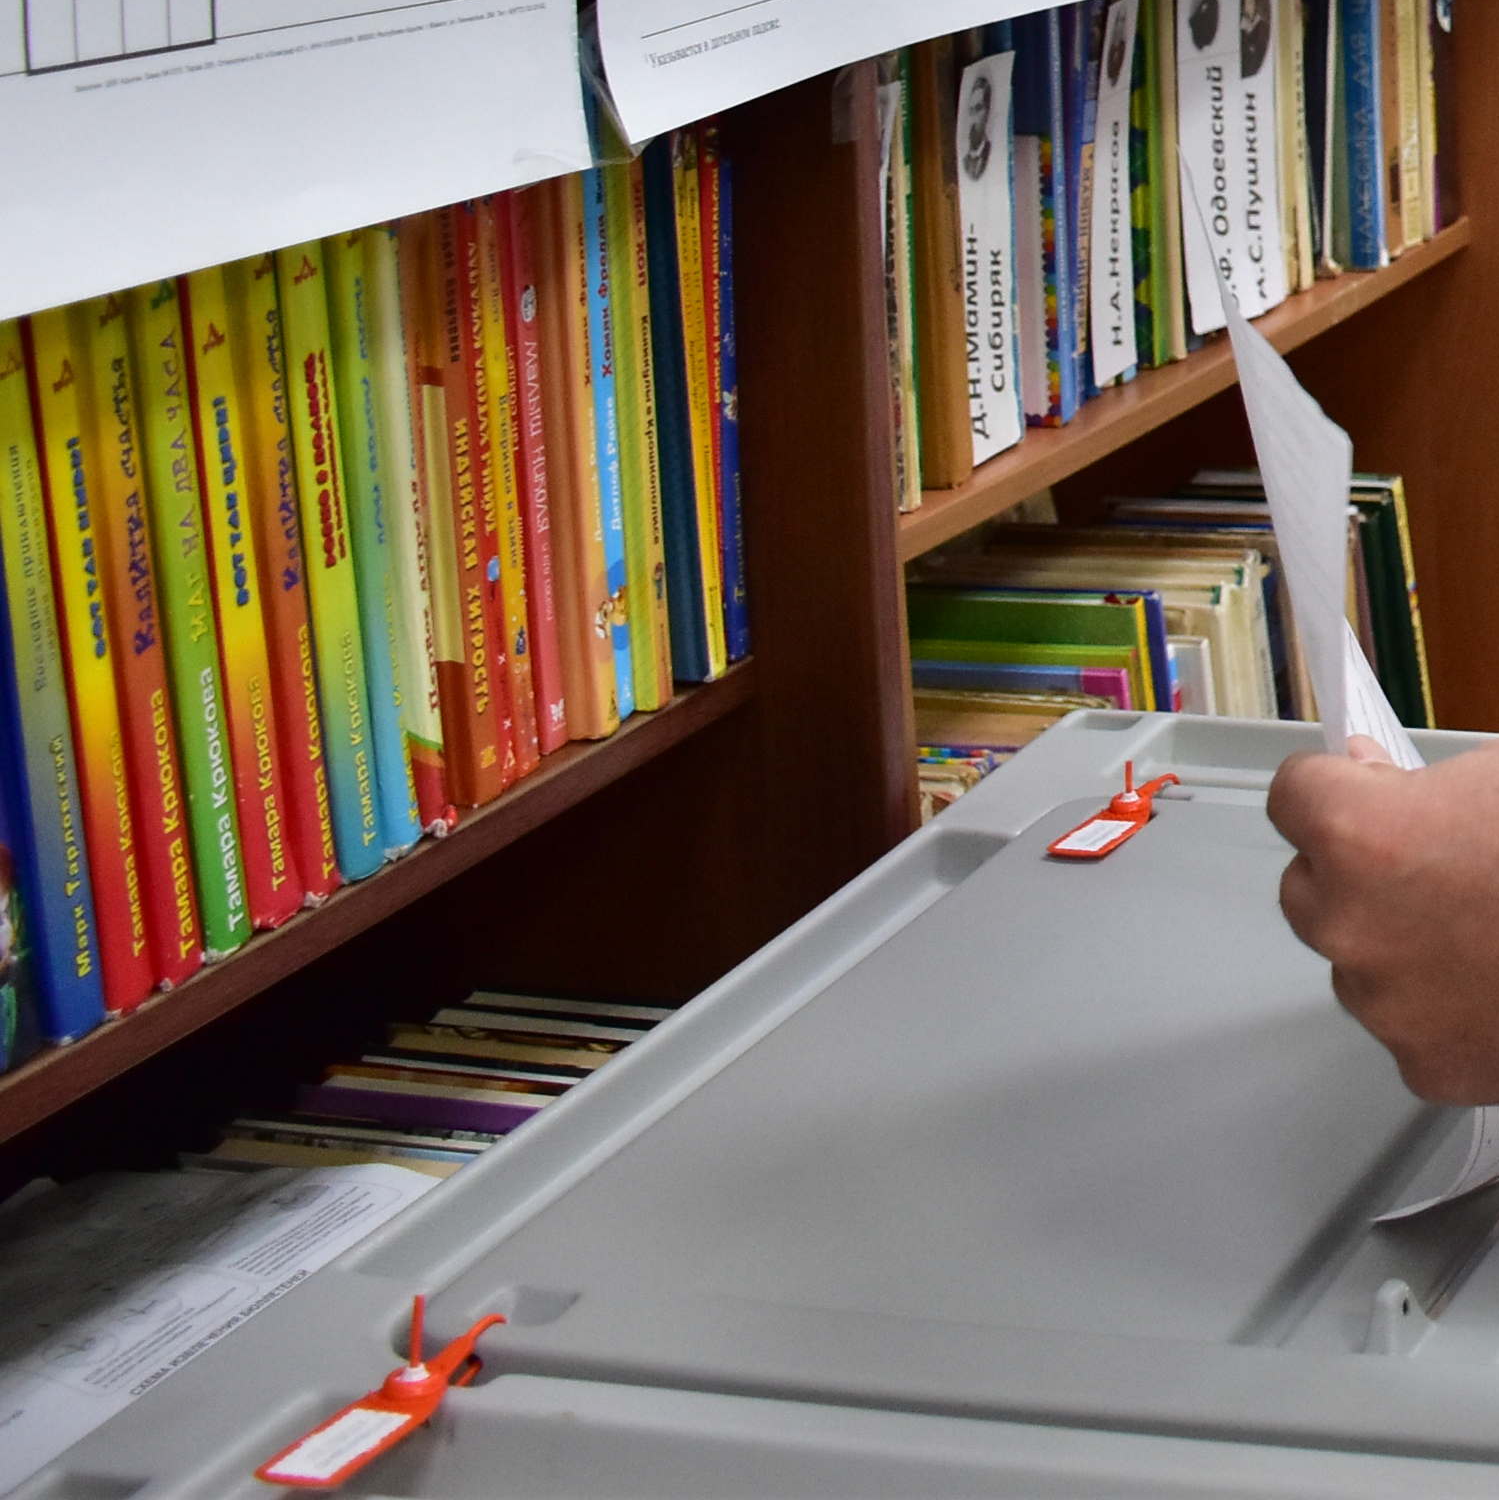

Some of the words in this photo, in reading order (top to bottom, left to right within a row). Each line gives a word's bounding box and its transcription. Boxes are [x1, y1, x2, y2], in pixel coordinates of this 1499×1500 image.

[1205, 65, 1229, 236] Одоевский
[596, 214, 608, 299] Фредди
[1108, 121, 1124, 347] Н.А.Некрасов
[159, 330, 183, 422] ЧАСА
[601, 306, 614, 378] Хомяк
[987, 249, 1006, 393] Сибиряк
[524, 342, 544, 437] Малыш
[170, 428, 194, 493] ДВА
[532, 445, 550, 533] Николя
[453, 419, 478, 571] ИНДЕЙСКАЯ
[466, 585, 489, 715] ХИТРОСТЬ
[198, 666, 229, 809] Крюкова
[246, 675, 273, 791] Крюкова
[339, 630, 364, 746] Крюкова
[49, 736, 81, 897] Тарловский
[108, 728, 133, 851] Крюкова
[148, 688, 179, 834] Крюкова
[354, 751, 377, 846] Тамара
[167, 837, 196, 959] Тамара
[214, 812, 245, 931] Тамара
[264, 794, 286, 891] Тамара
[72, 904, 93, 979] Марк
[122, 855, 147, 957] Тамара
[130, 1367, 171, 1395] СХЕМА
